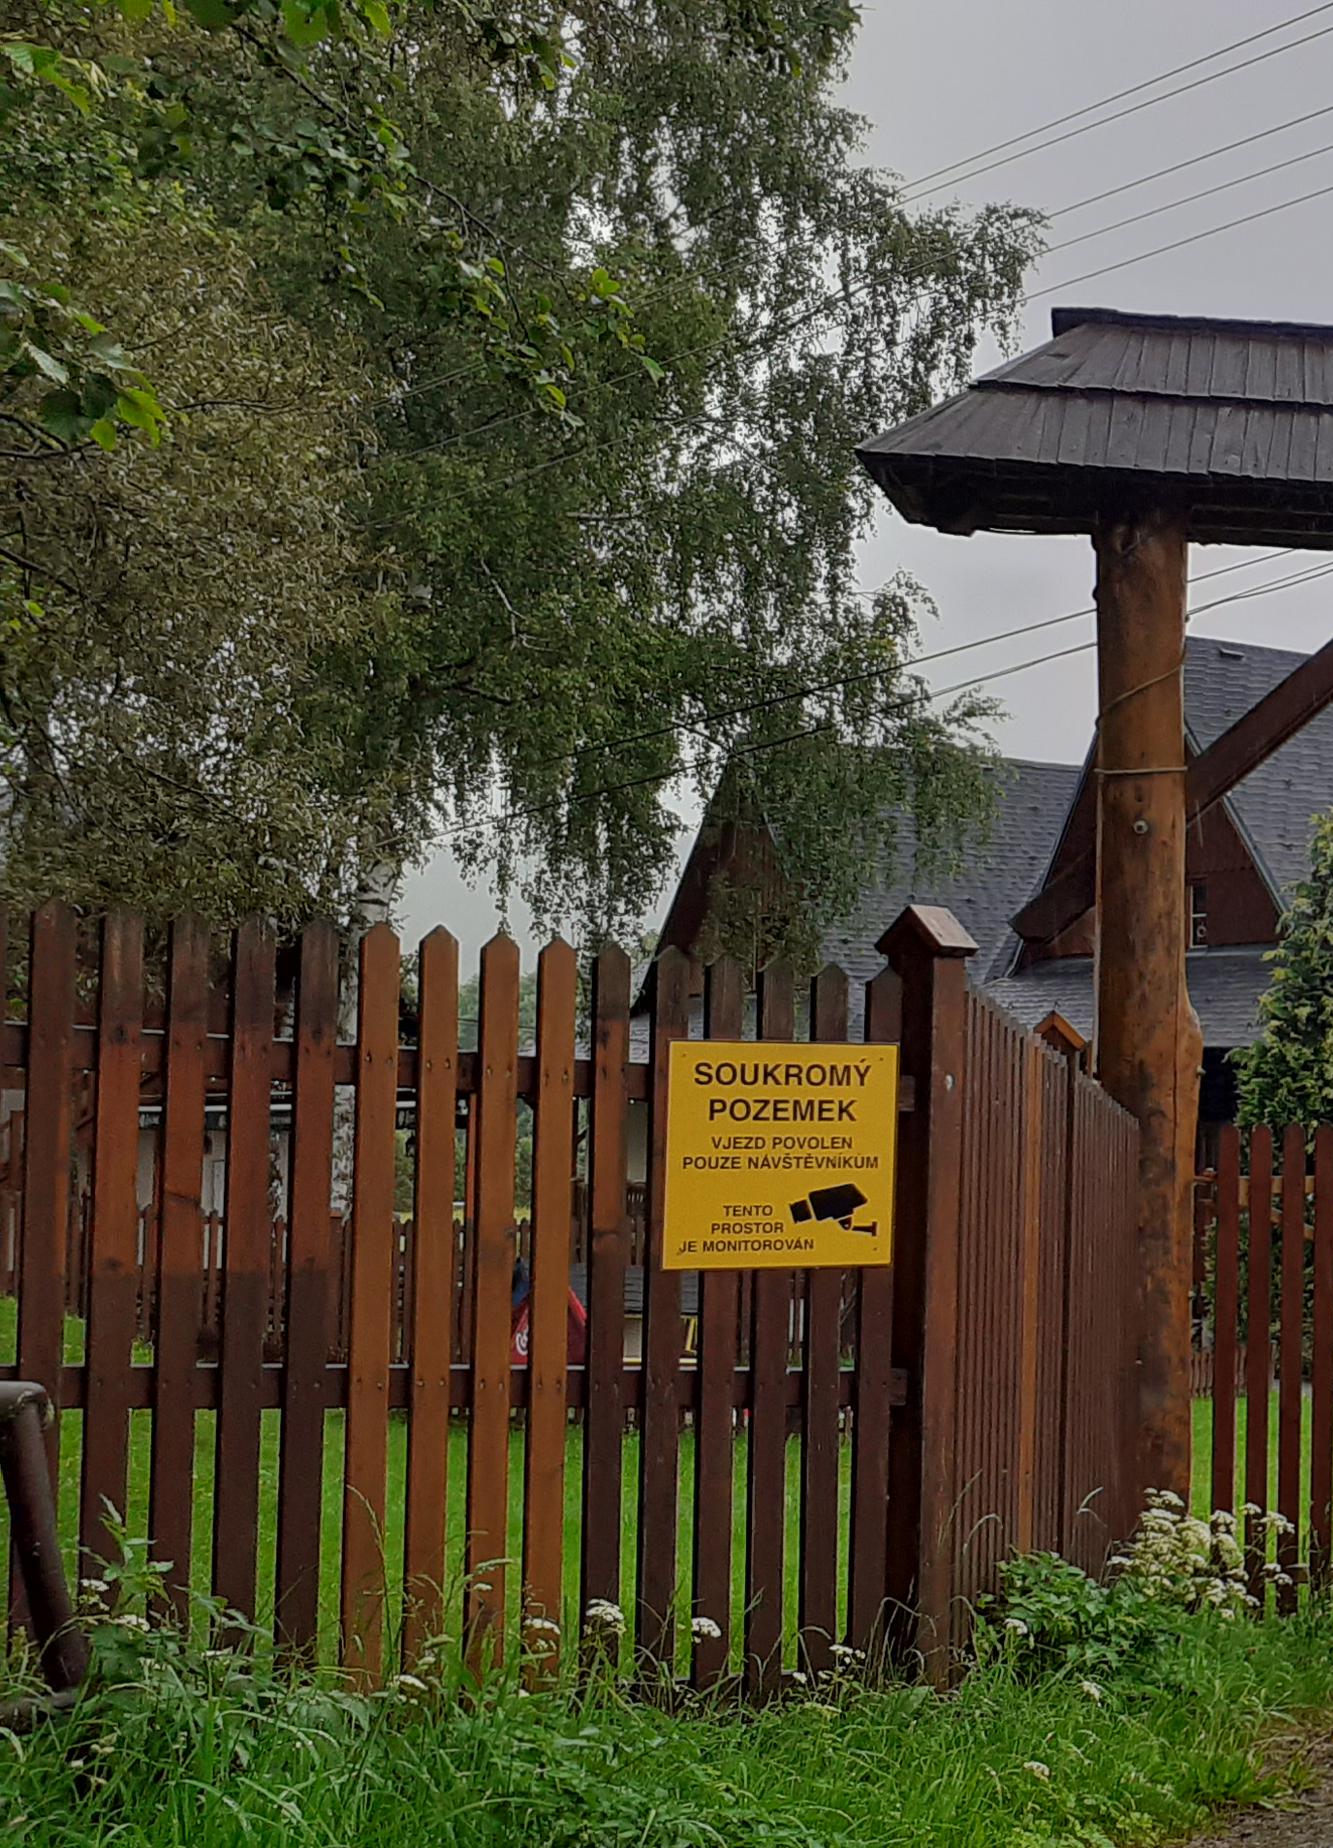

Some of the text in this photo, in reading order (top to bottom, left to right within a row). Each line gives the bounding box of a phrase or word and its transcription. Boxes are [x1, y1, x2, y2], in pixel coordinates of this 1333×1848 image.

[694, 1058, 872, 1087] SOUKROMÝ
[708, 1098, 857, 1122] POZEMEK
[711, 1136, 853, 1150] VJEZD POVOLEN
[682, 1152, 879, 1170] POUZE NÁVŠTĚVNÍKŮM
[723, 1204, 774, 1217] TENTO
[711, 1222, 784, 1234] PROSTOR
[679, 1238, 815, 1254] JE MONITOROVÁN
